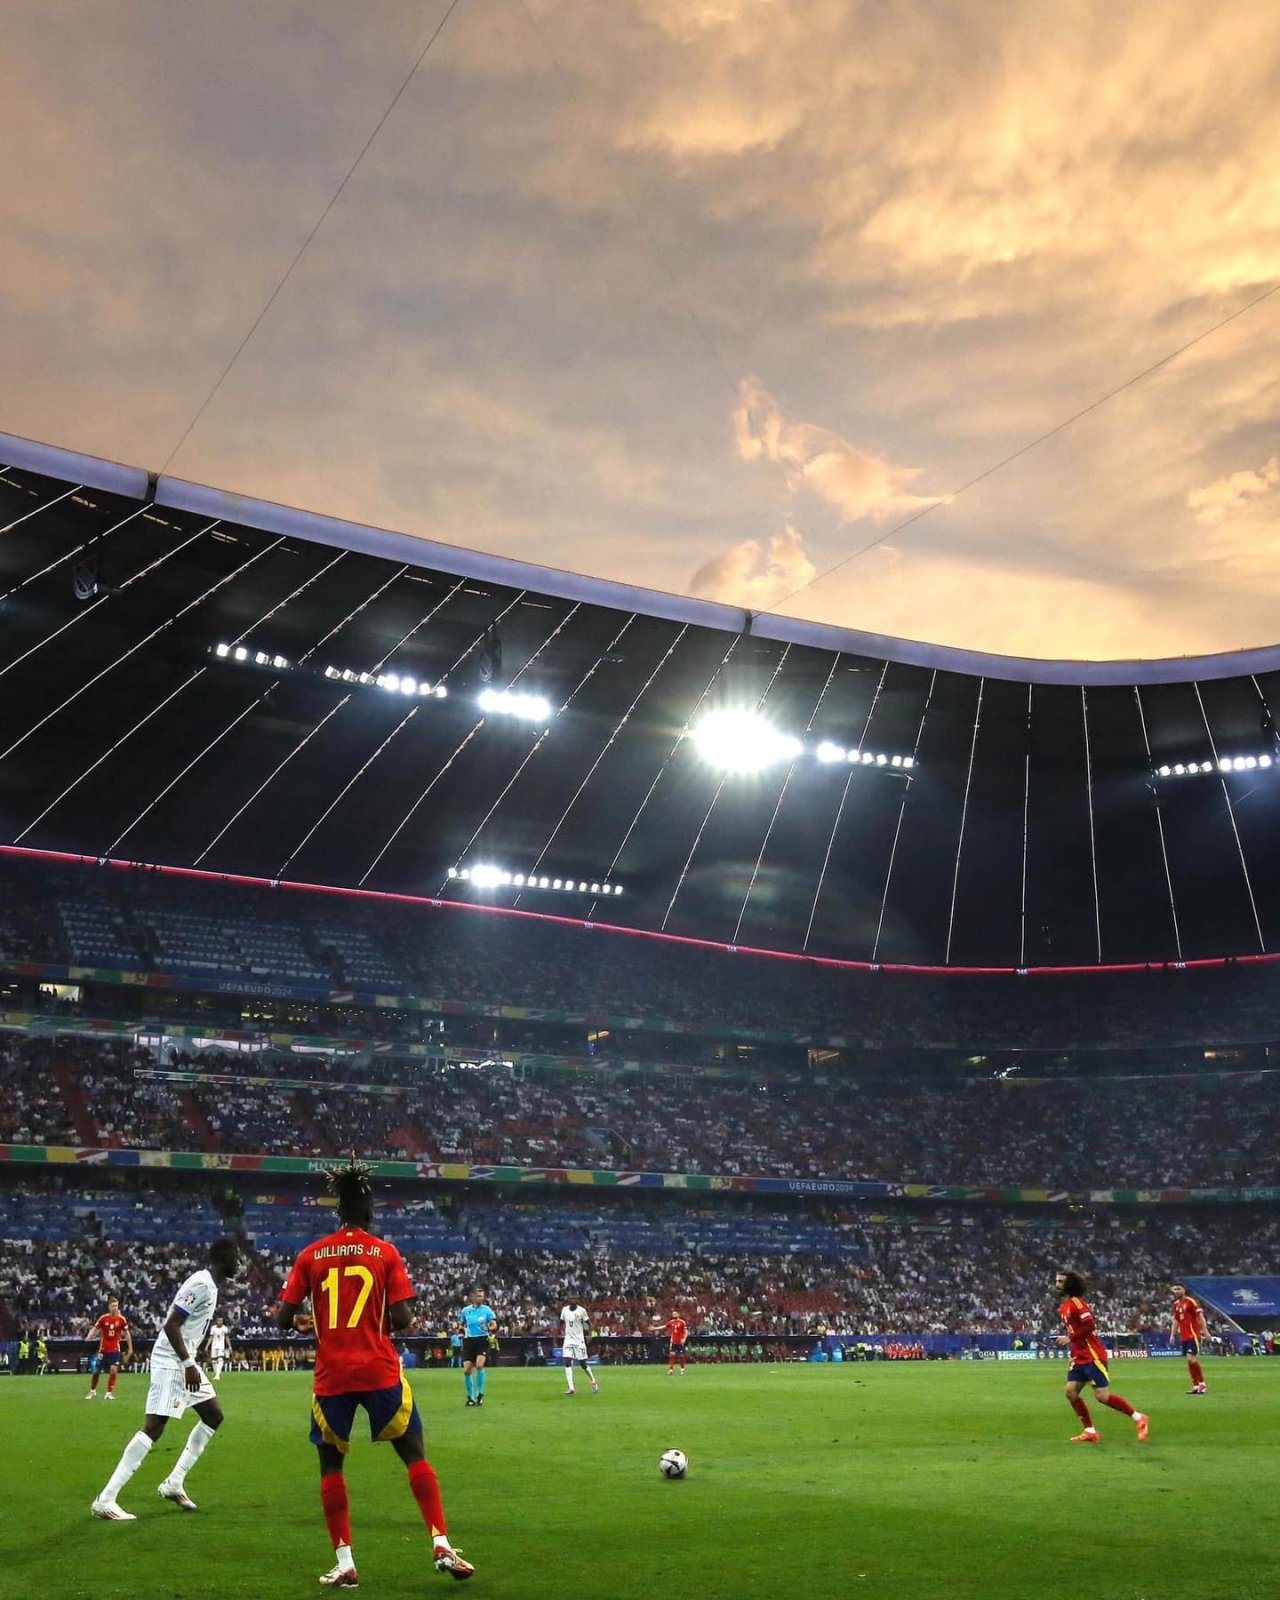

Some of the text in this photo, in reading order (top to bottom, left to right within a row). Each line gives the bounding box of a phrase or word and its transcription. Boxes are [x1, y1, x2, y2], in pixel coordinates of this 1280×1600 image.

[313, 1244, 383, 1260] WILLIAMS JR.
[321, 1265, 374, 1330] 17
[997, 1351, 1037, 1361] Hisense
[1119, 1350, 1148, 1358] STRAUSS
